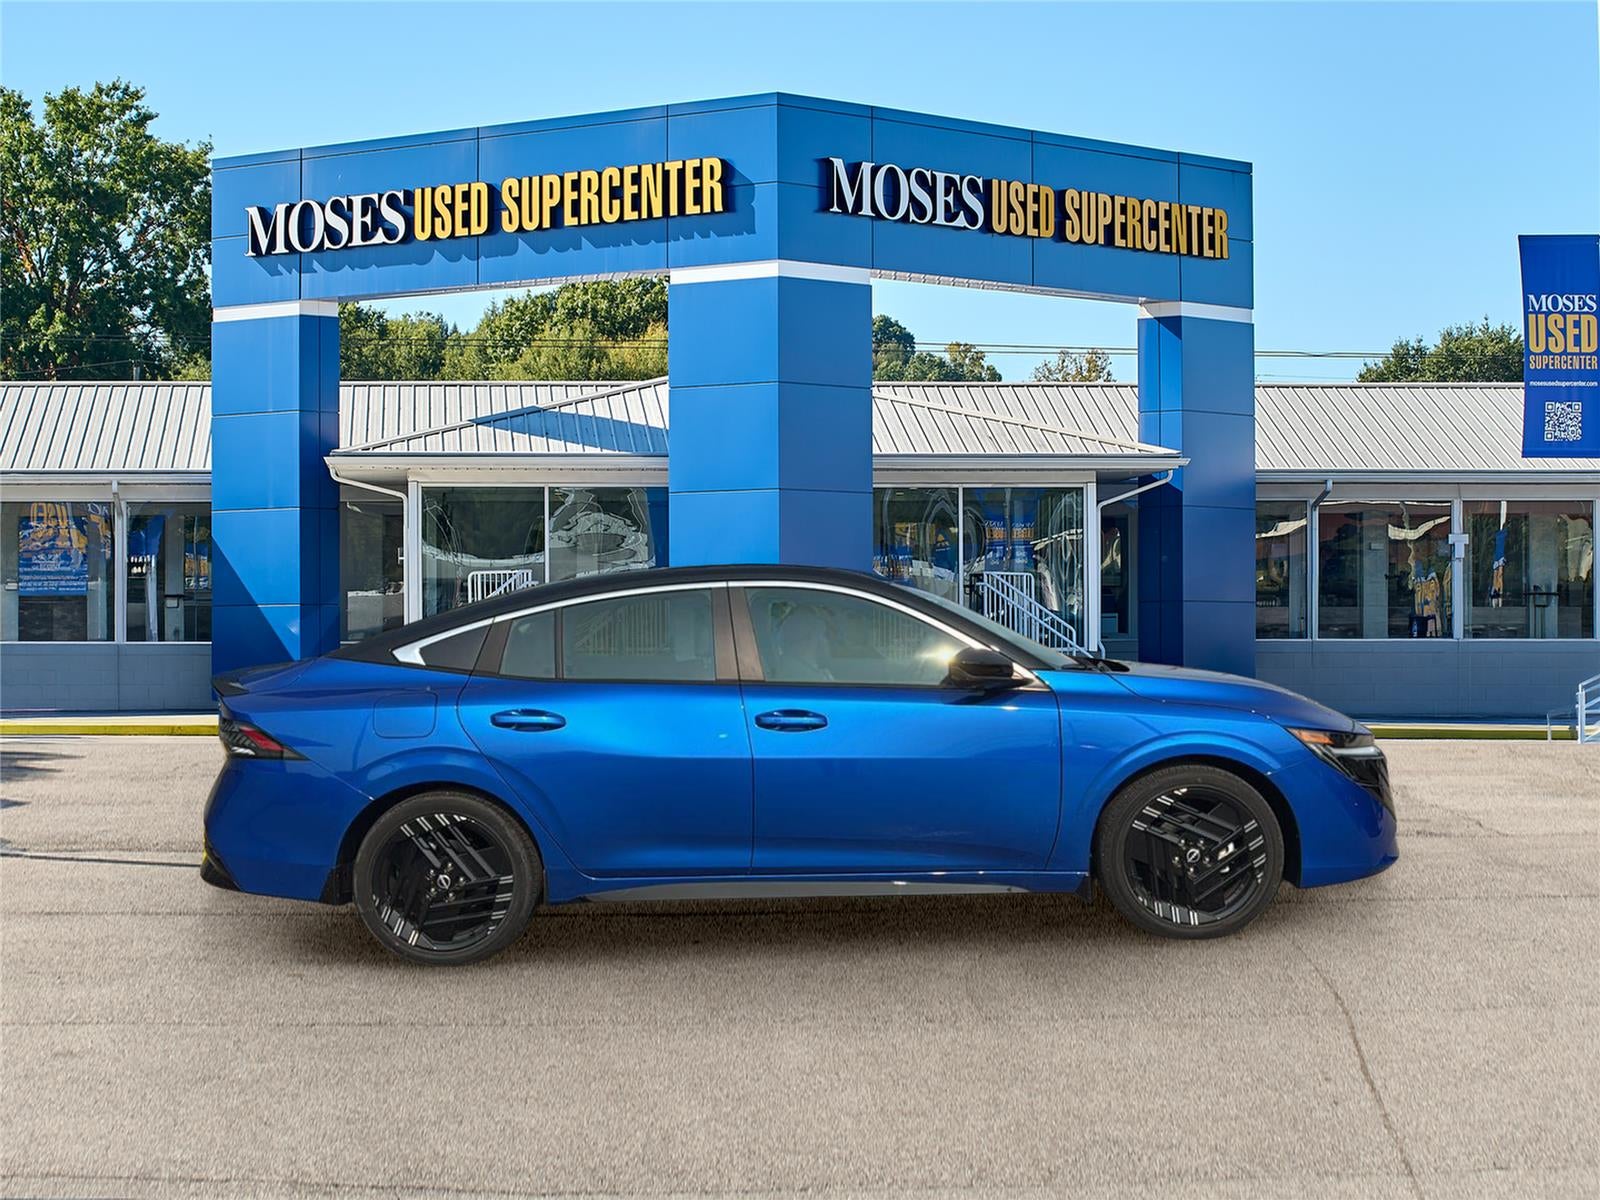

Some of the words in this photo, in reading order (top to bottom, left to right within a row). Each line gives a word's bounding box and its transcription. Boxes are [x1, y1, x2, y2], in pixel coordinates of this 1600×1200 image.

[245, 190, 406, 257] MOSES
[413, 182, 488, 241] USED
[501, 157, 724, 233] SUPERCENTER
[829, 157, 984, 230] MOSES
[991, 178, 1055, 238] USED
[1065, 188, 1229, 259] SUPERCENTER
[1527, 294, 1597, 312] MOSES
[1528, 313, 1598, 353] USED
[1529, 355, 1598, 370] SUPERCENTER
